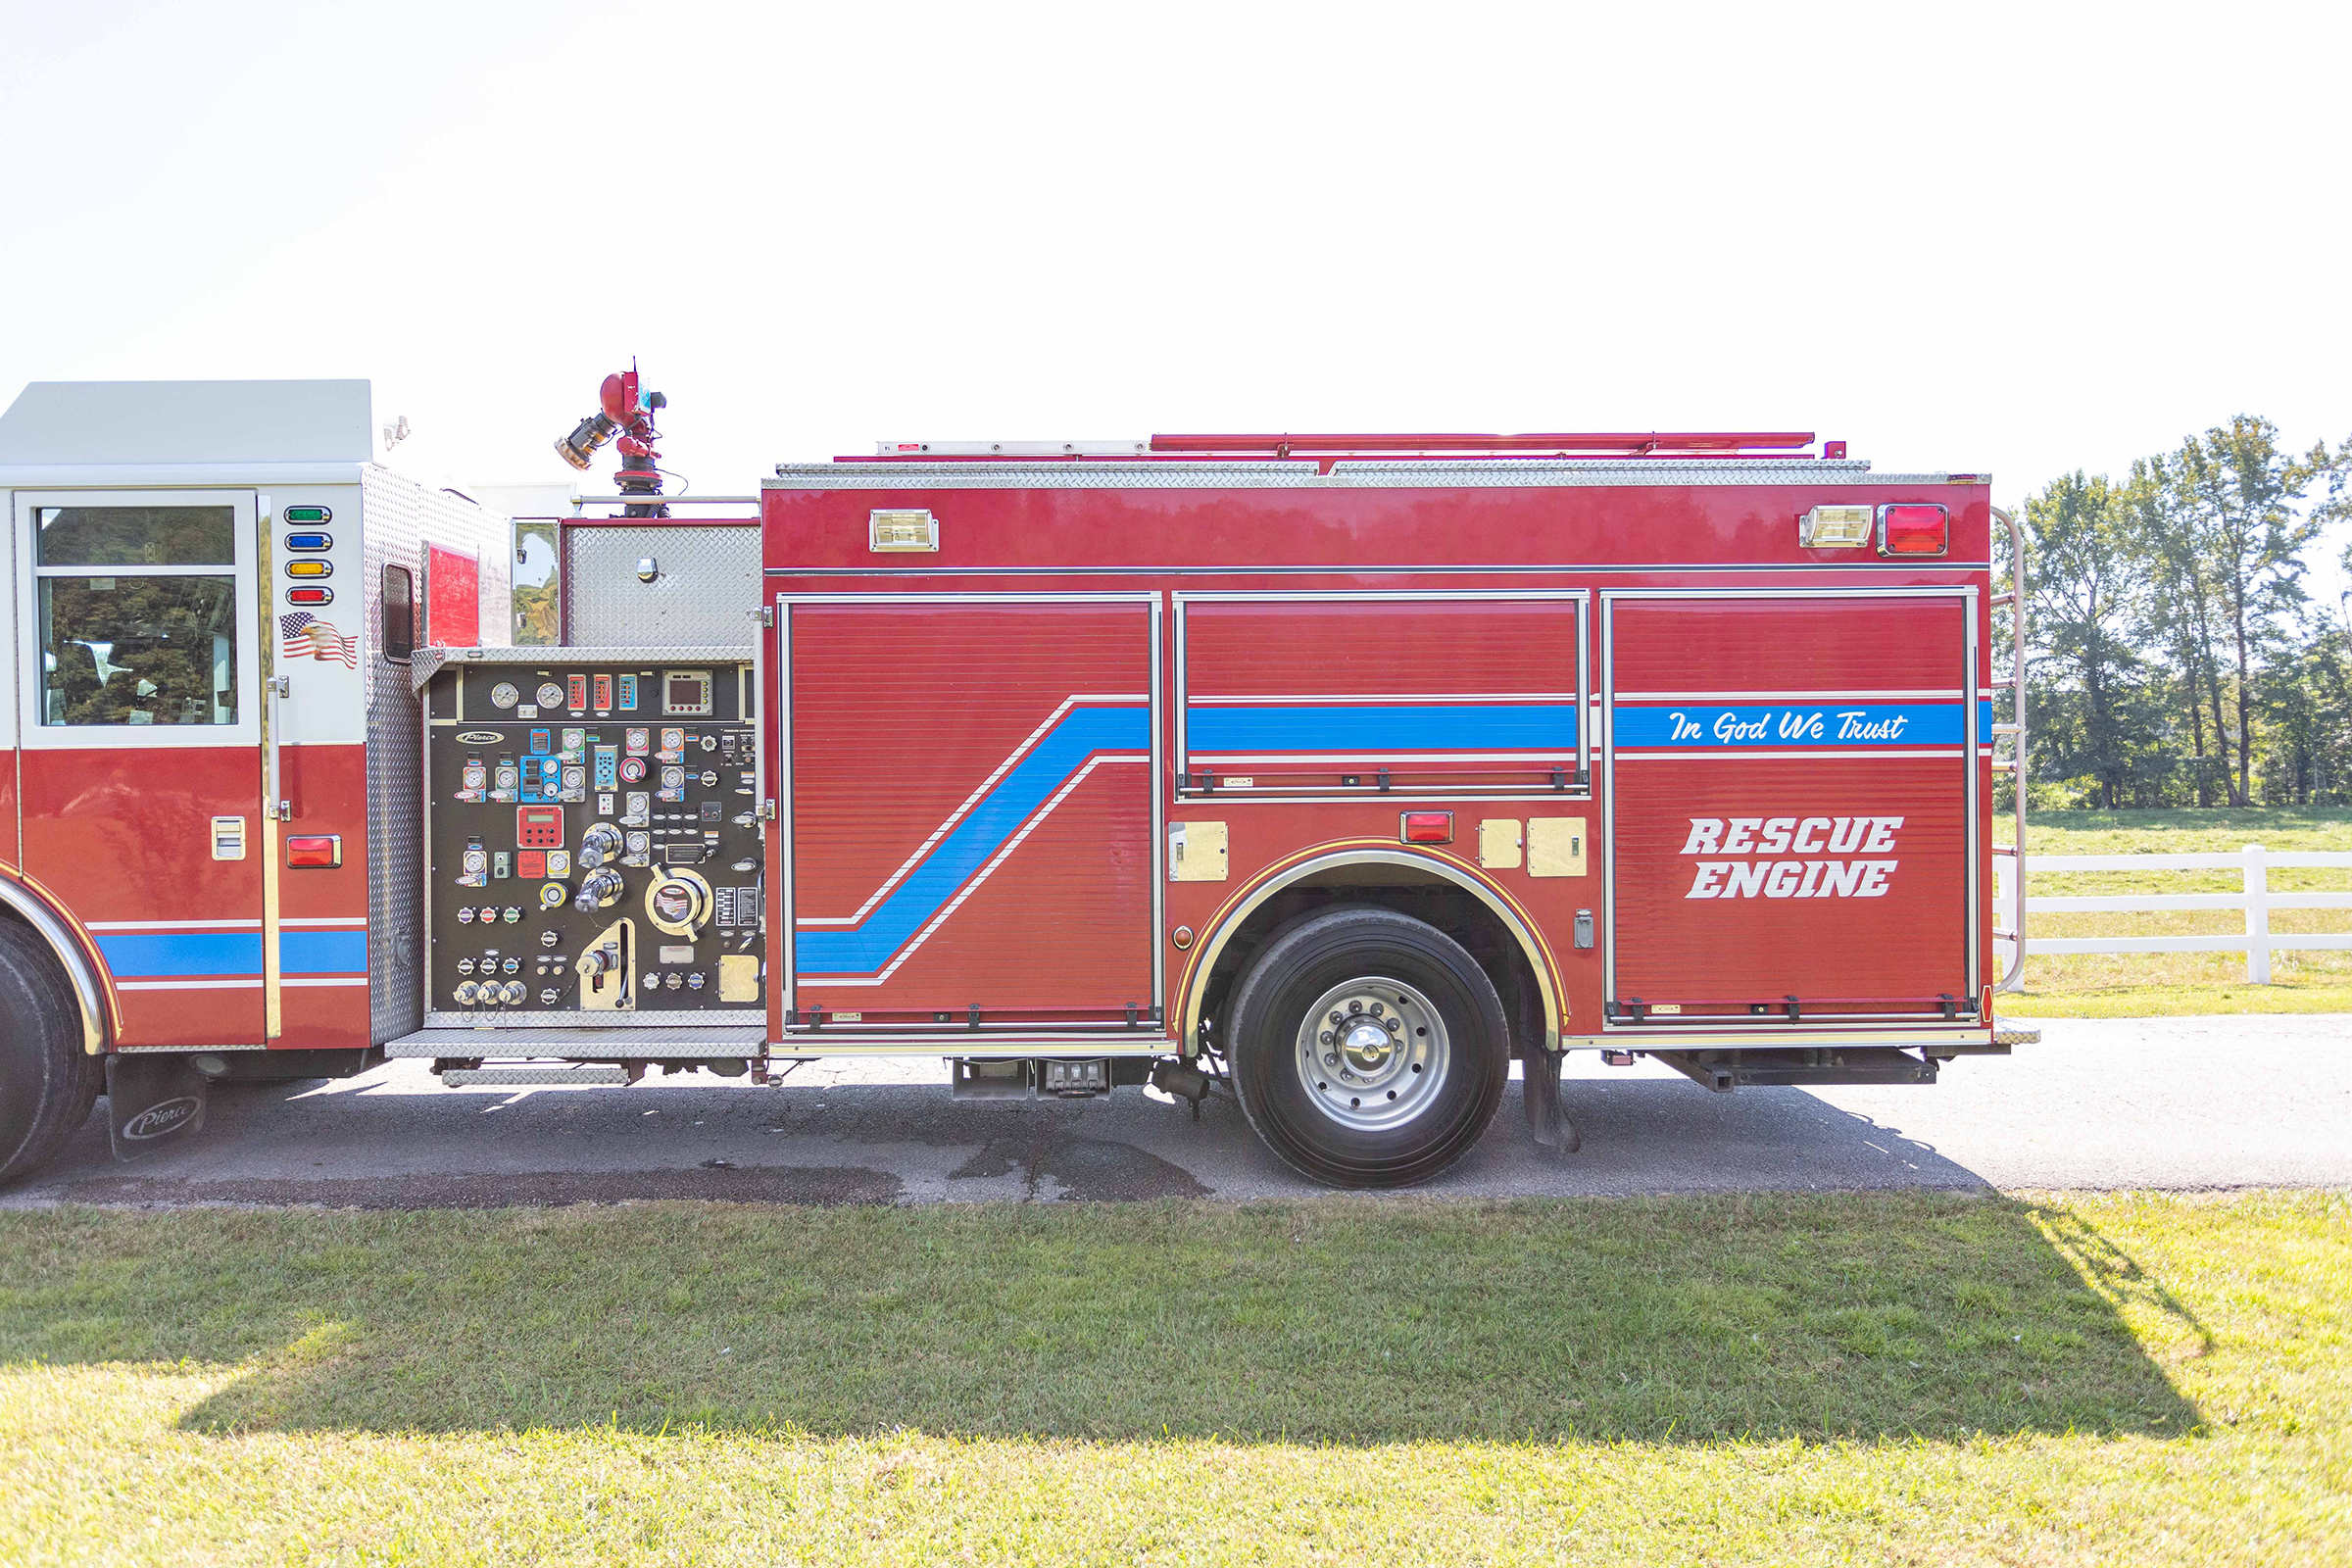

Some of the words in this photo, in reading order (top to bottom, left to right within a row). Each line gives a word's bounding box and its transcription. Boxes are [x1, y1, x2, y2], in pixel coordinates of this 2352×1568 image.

[464, 733, 496, 742] Pierce
[1668, 711, 1702, 741] In
[1713, 711, 1772, 744] God
[1778, 711, 1824, 740] We
[1837, 711, 1908, 740] Trust
[1679, 816, 1904, 855] RESCUE
[1684, 859, 1899, 899] ENGINE
[138, 1102, 190, 1134] Pierce
